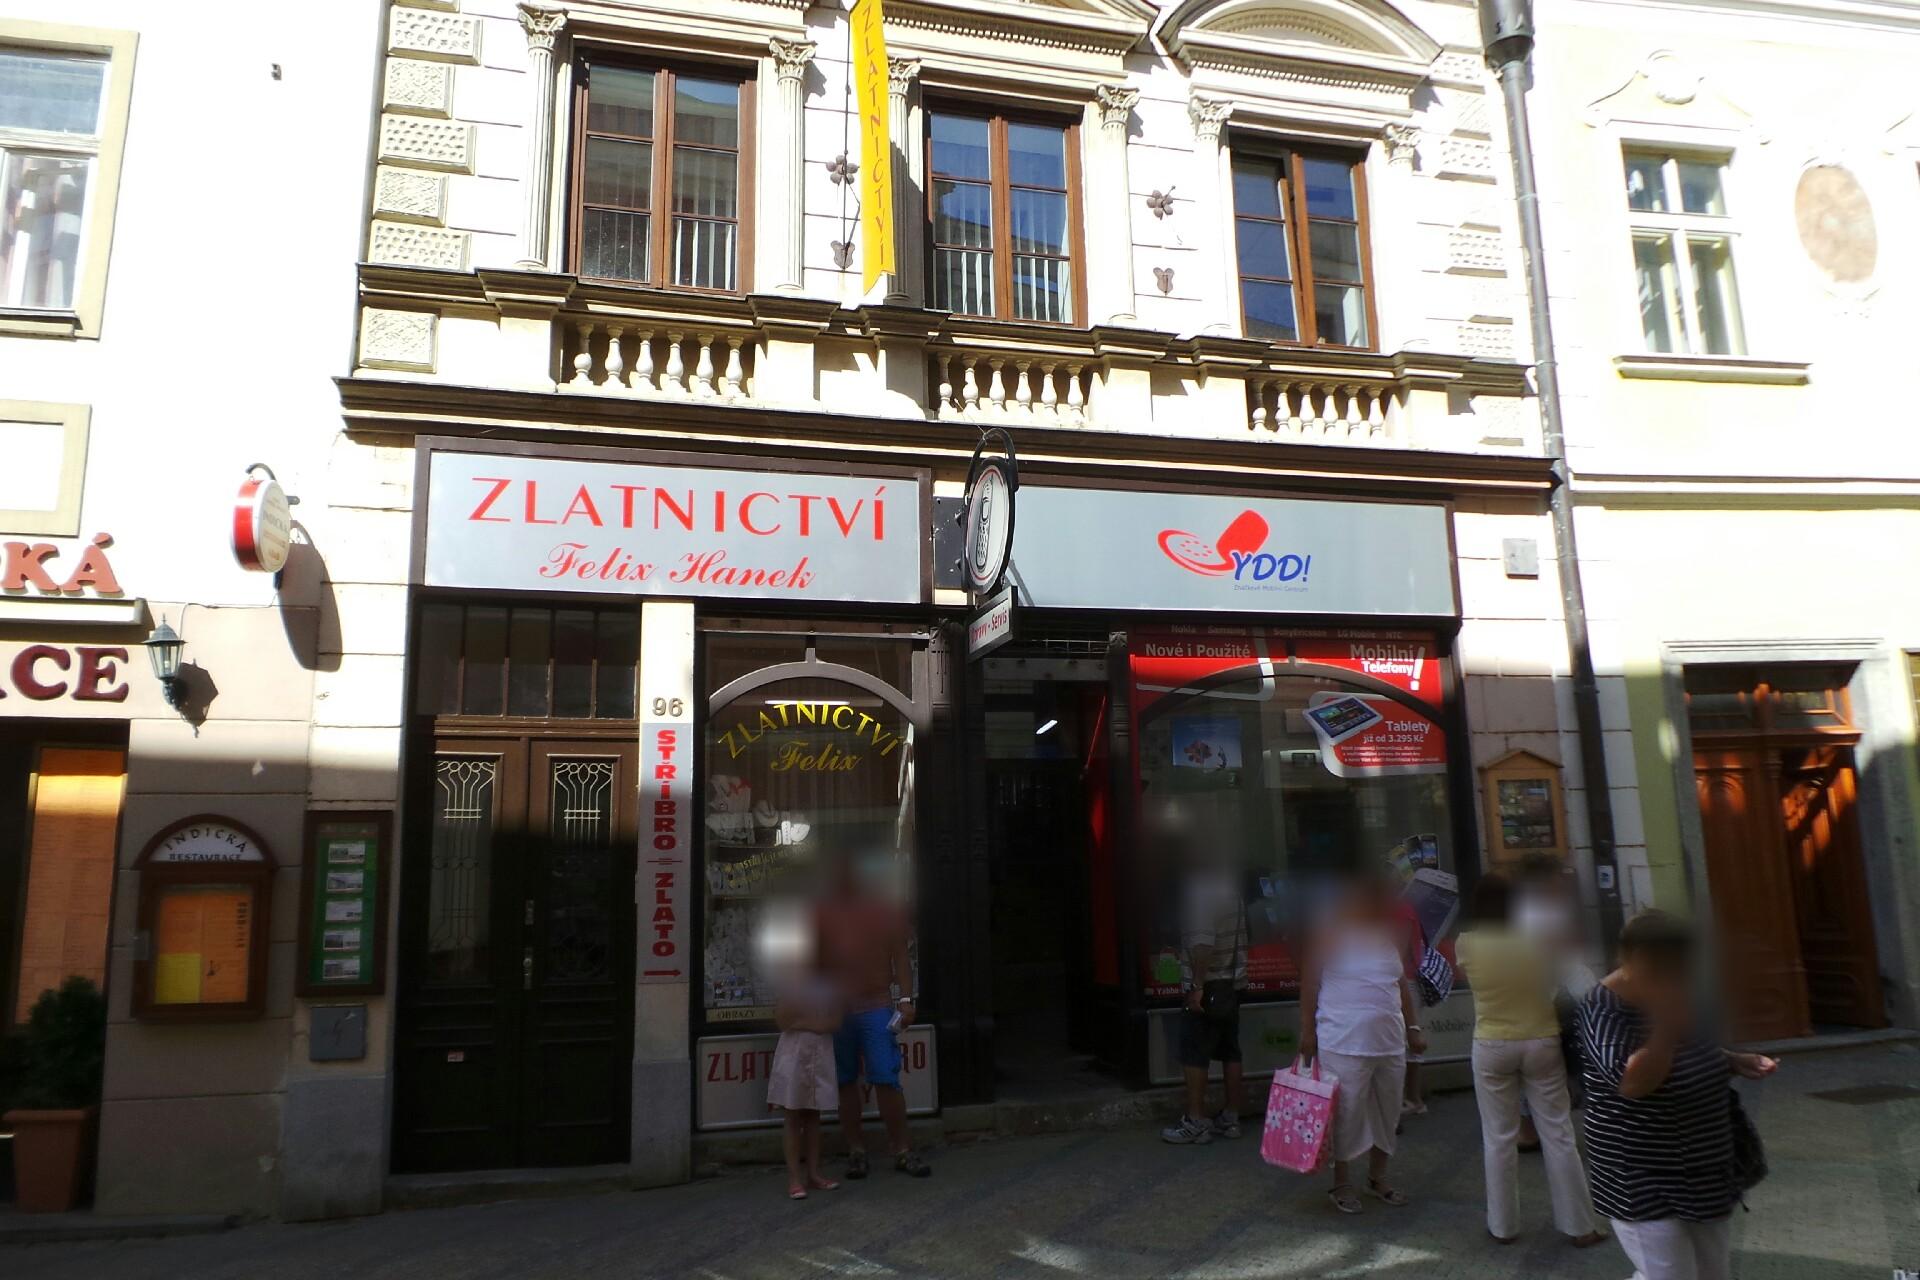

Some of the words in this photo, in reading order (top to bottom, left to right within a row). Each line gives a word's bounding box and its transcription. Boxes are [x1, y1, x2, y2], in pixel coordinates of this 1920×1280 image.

[862, 8, 885, 265] ZLATNICTVÍ
[468, 477, 886, 541] ZLATNICTVÍ
[0, 532, 124, 598] KÁ
[539, 542, 658, 582] Felix
[669, 549, 816, 589] Hanek
[0, 645, 129, 702] CE
[1145, 643, 1184, 657] Nové
[1187, 643, 1192, 657] i
[1197, 643, 1251, 658] Použité
[652, 697, 684, 717] 96
[717, 702, 905, 759] ZLATNICTVÍ
[1385, 720, 1431, 734] Tablety
[770, 740, 863, 773] Felix
[1375, 734, 1386, 742] od
[1388, 734, 1412, 743] 3.295
[653, 730, 677, 851] STŘÍBRO
[164, 827, 247, 853] INDICKÁ
[652, 873, 676, 957] ZLATO
[707, 1050, 775, 1083] ZLAT
